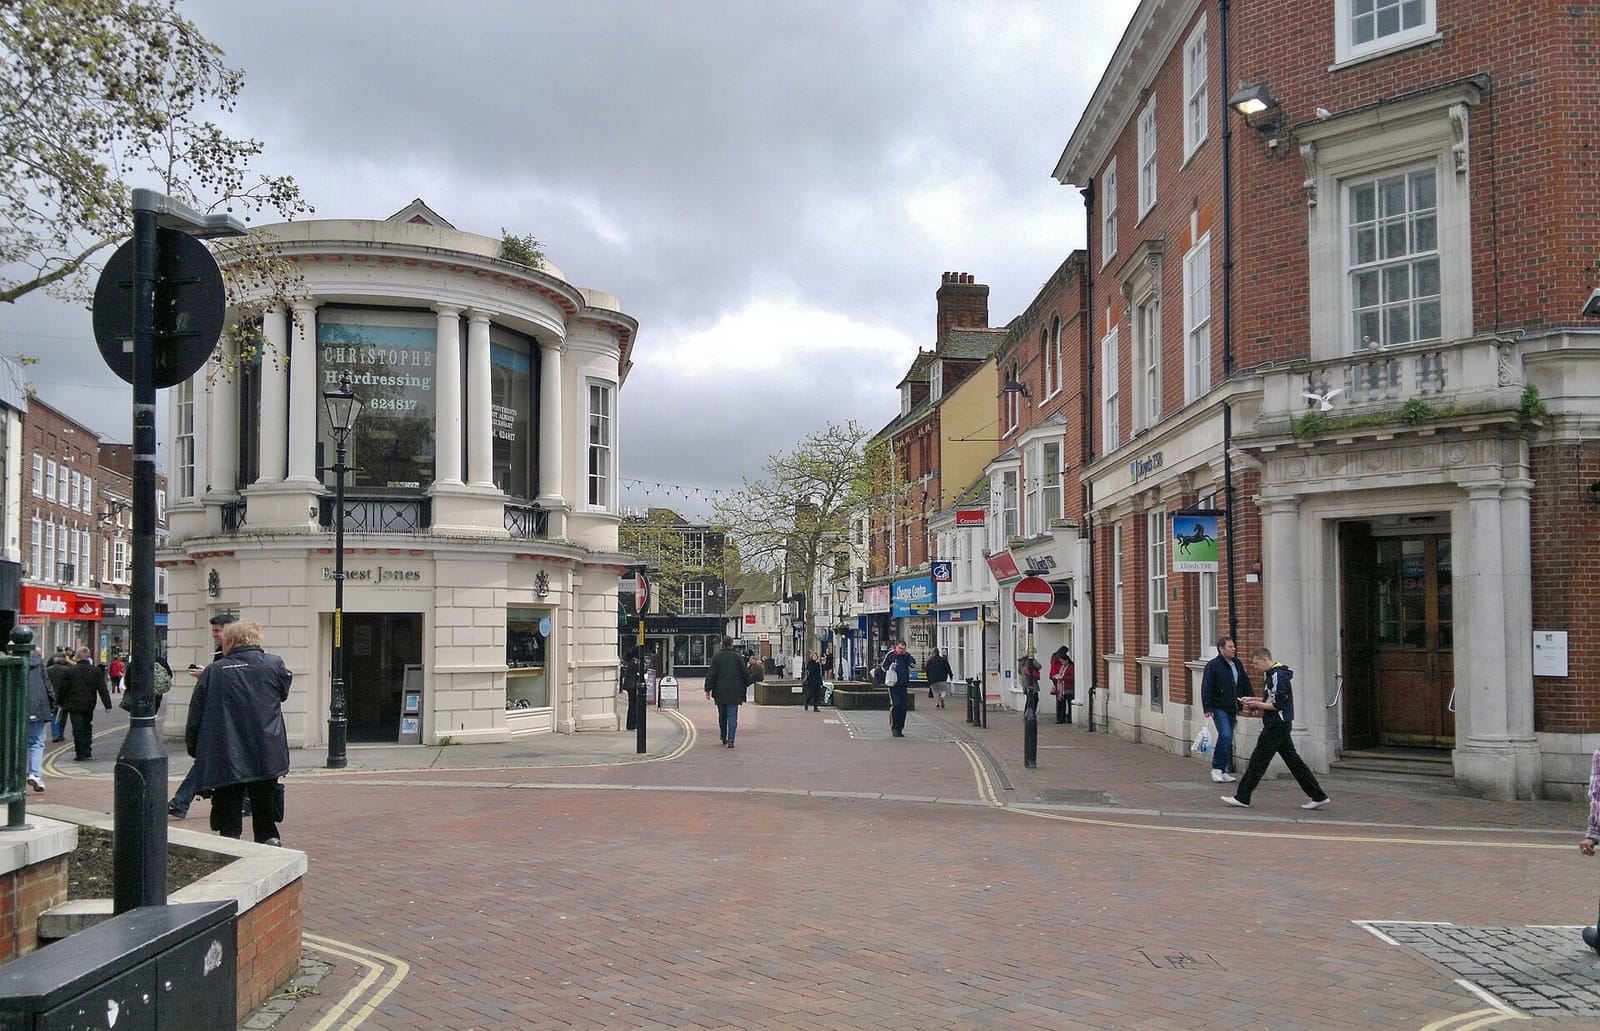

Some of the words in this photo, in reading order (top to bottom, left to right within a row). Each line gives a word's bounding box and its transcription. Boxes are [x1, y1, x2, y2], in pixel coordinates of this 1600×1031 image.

[324, 347, 432, 367] CHRiSTOPHE
[324, 369, 432, 391] Hairdressing
[370, 398, 417, 410] 624817
[374, 566, 421, 584] Jones
